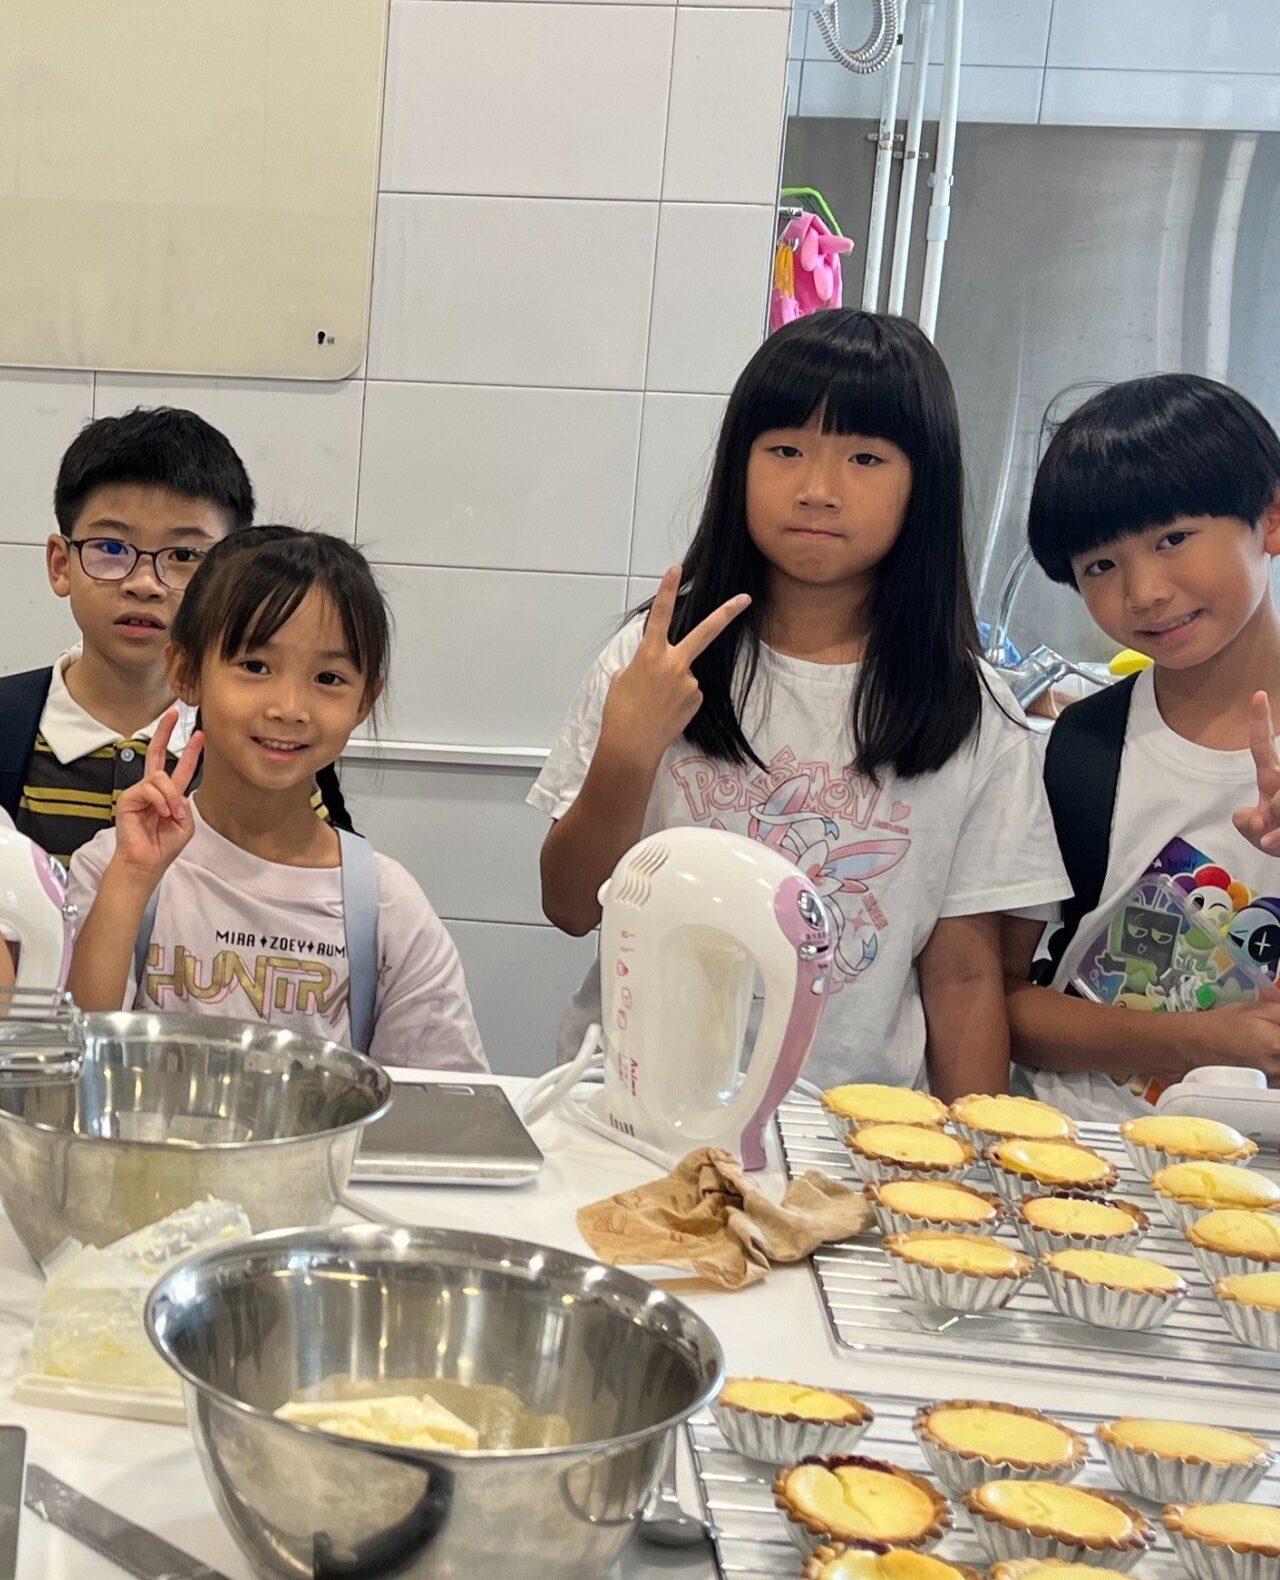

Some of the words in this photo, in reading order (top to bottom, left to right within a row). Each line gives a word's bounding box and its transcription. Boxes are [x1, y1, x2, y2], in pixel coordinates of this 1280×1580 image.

[216, 930, 256, 948] MIRA
[270, 935, 306, 953] ZOEY
[317, 942, 346, 959] RUM
